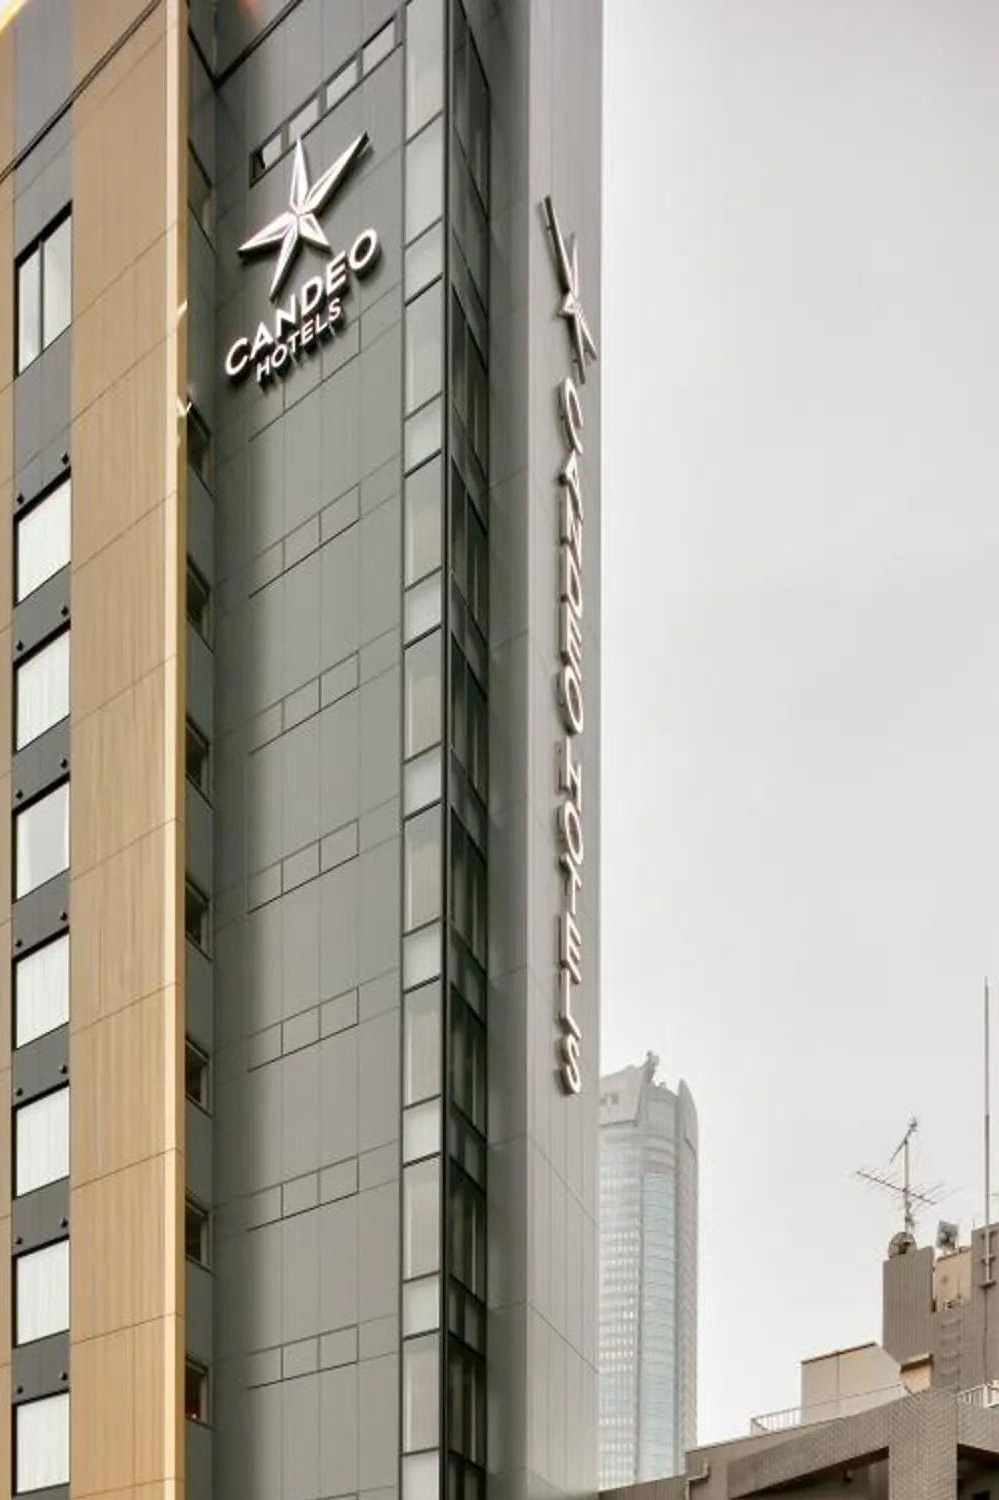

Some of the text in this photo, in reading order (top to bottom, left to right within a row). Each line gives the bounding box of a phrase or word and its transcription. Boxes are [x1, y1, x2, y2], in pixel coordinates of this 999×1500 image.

[224, 227, 379, 380] CANDEO
[256, 297, 344, 384] HOTELS
[557, 376, 584, 1094] CANDEO HOTELS
